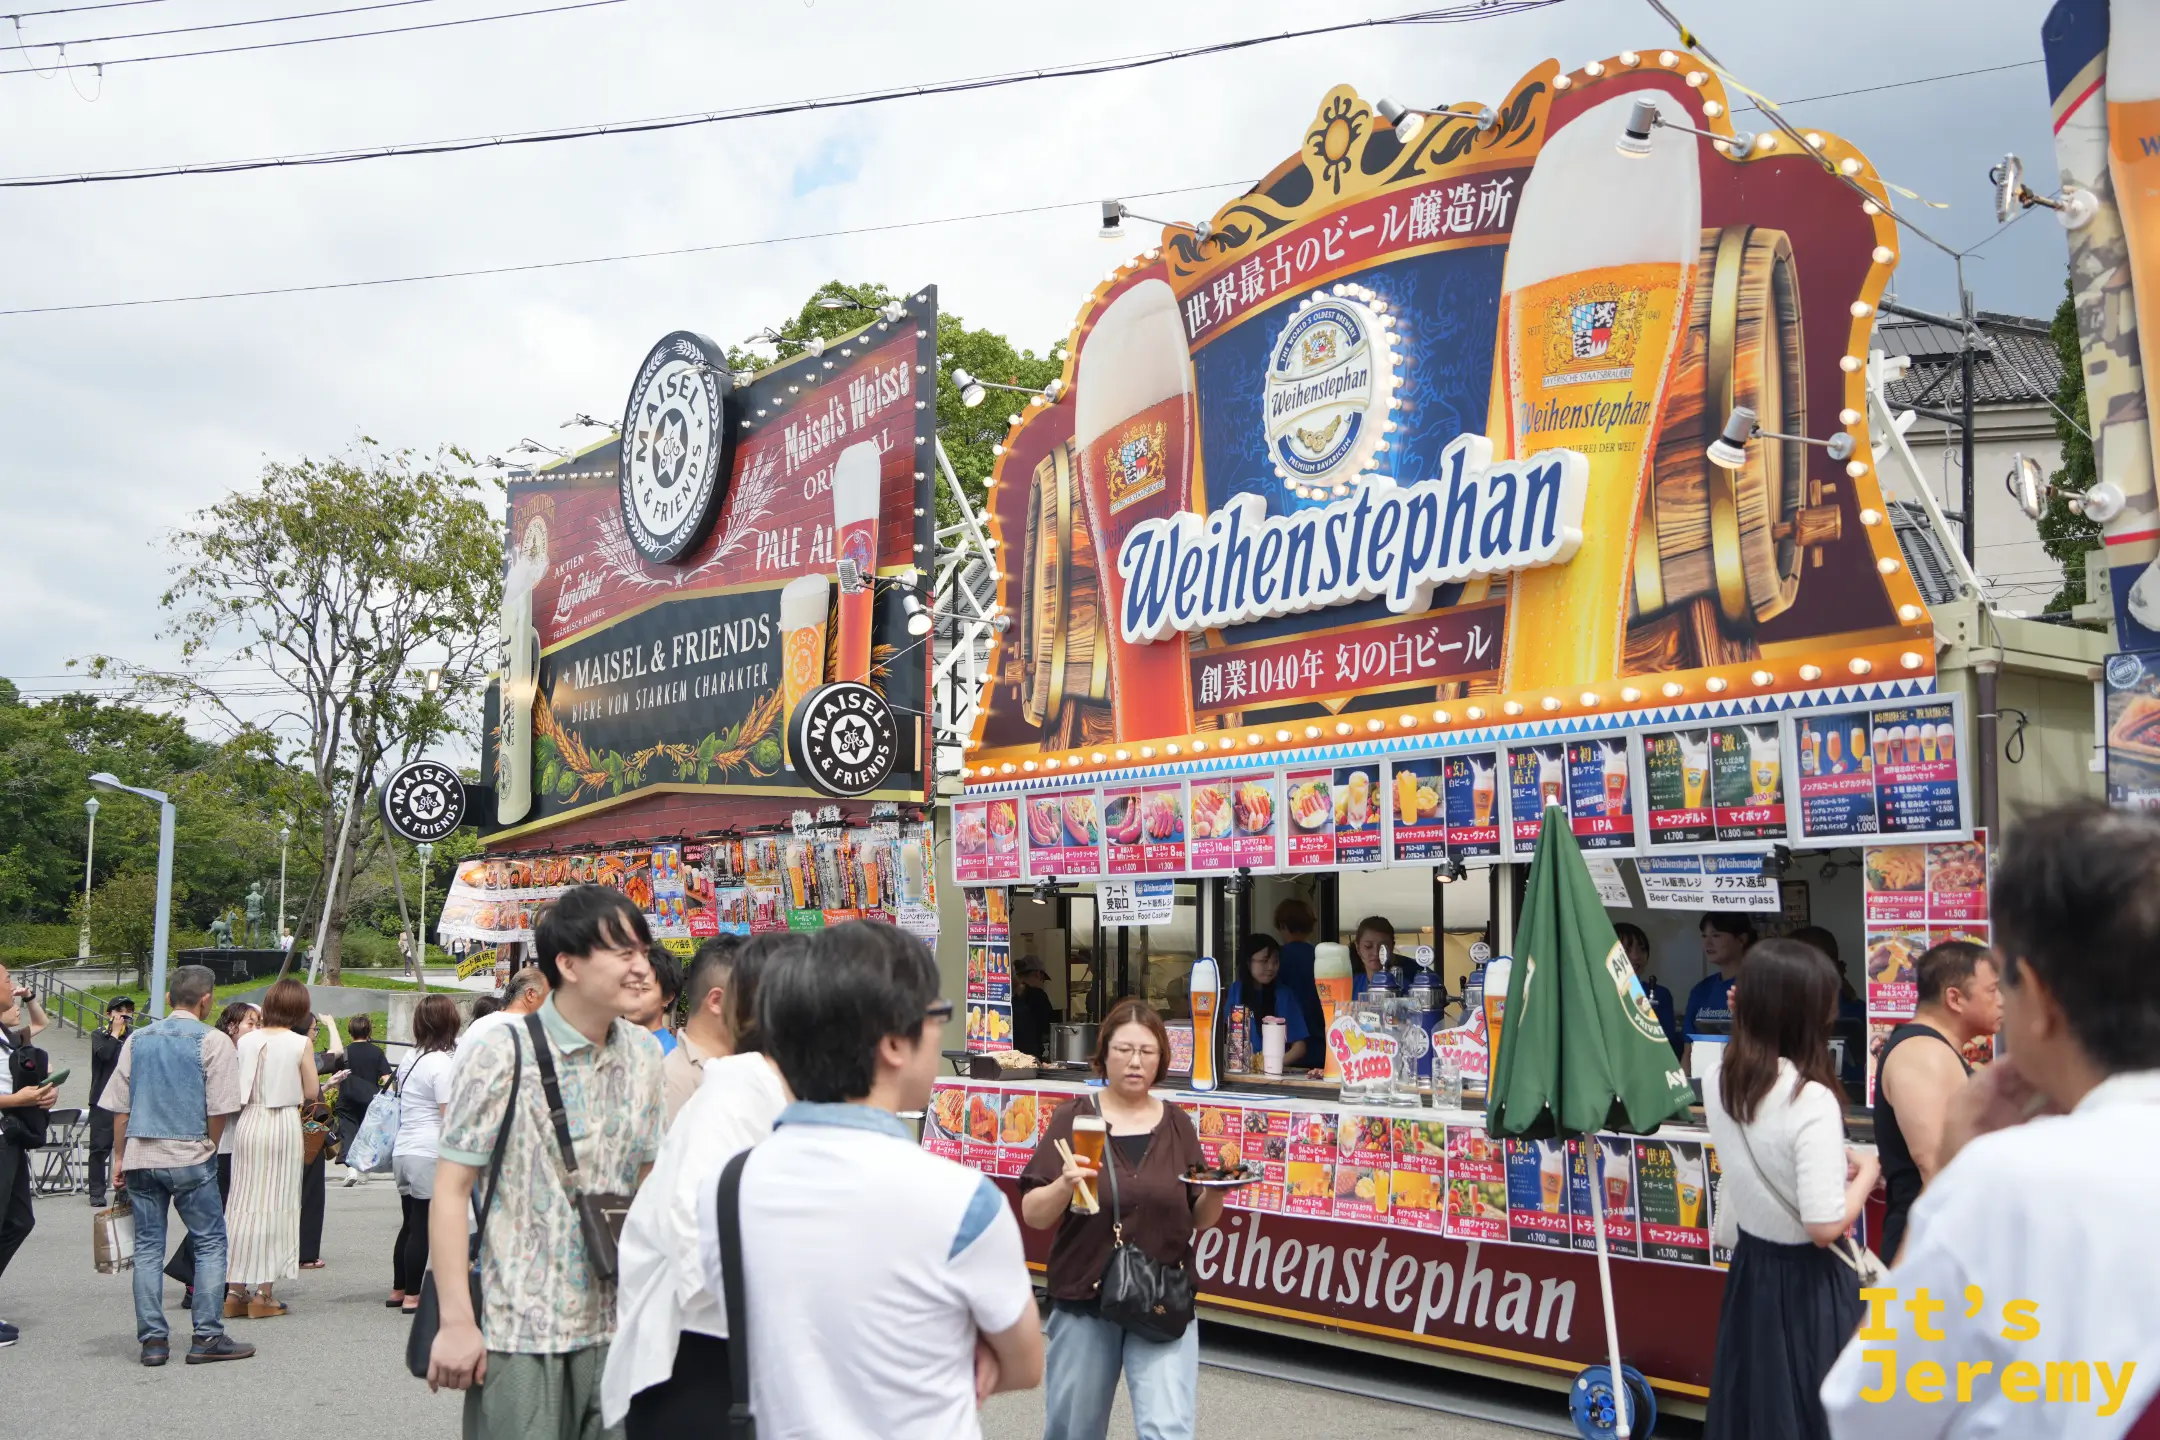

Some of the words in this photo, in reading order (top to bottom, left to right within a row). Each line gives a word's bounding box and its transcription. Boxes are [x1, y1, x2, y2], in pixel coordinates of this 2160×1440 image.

[1185, 176, 1514, 339] 世界最古のビール醸造所
[1280, 347, 1290, 362] THE
[1313, 310, 1336, 321] OLDEST
[1335, 311, 1358, 339] BREWERY
[1527, 324, 1542, 337] SEIT
[1272, 367, 1368, 417] Weihenstephan
[636, 373, 699, 463] MAISEL
[1520, 391, 1650, 436] Weihenstephan
[1599, 442, 1615, 453] DER
[1617, 441, 1636, 452] WELT
[804, 427, 895, 500] ORIAL
[1288, 455, 1316, 473] PREMIUM
[1316, 439, 1352, 471] BAVARICUM
[644, 487, 653, 507] &
[653, 444, 702, 522] FRIENDS
[756, 527, 803, 571] PALE
[809, 524, 837, 564] AL
[1123, 446, 1562, 634] Weihenstephan
[554, 554, 585, 580] AKTIEN
[574, 644, 647, 690] MAISEL
[650, 639, 666, 673] &
[672, 613, 770, 668] FRIENDS
[1199, 649, 1325, 705] 創業1040年
[1335, 625, 1493, 683] 幻の白ビール
[2110, 661, 2137, 680] LIMITED
[572, 698, 602, 723] BIERE
[608, 692, 628, 716] VON
[636, 680, 687, 711] STARKEM
[695, 662, 768, 699] CHARAKTER
[810, 692, 888, 742] MAISEL
[1654, 738, 1678, 757] 世界
[821, 756, 834, 772] &
[833, 744, 890, 786] FRIENDS
[392, 767, 454, 805] MAISEL
[1449, 779, 1471, 788] 白ビール
[1802, 781, 1838, 791] ノンアルコール
[401, 814, 411, 827] &
[412, 803, 458, 835] FRIENDS
[1656, 812, 1707, 826] ヤーフンデルト
[1729, 810, 1771, 822] マイボック
[1592, 819, 1614, 832] IPA
[1851, 822, 1877, 832] ¥1,000
[1450, 830, 1497, 841] ヘフェ・ヴァイス
[1651, 858, 1699, 870] Weihenstephan
[1718, 857, 1762, 869] Weihensteph
[1645, 876, 1702, 888] ビール販売レジ
[1714, 876, 1767, 888] グラス返却
[1105, 885, 1128, 897] フード
[1650, 893, 1668, 902] Beer
[1671, 893, 1704, 904] Cashier
[1106, 898, 1129, 910] 受取口
[1137, 899, 1171, 908] フード販売レジ
[1712, 895, 1746, 905] Return
[1749, 895, 1775, 907] glass
[1152, 911, 1170, 919] Cashier
[1945, 910, 1967, 918] ¥1,500
[1365, 1037, 1397, 1055] DEPOSIT
[1433, 1031, 1465, 1047] DEPOSIT
[1511, 1155, 1537, 1166] 白ビール
[1646, 1148, 1671, 1166] 世界
[1643, 1181, 1673, 1190] ラガービール
[1514, 1214, 1567, 1229] ヘフェ・ヴァイス
[1648, 1228, 1703, 1244] ヤーフンデルト
[1657, 1248, 1678, 1258] ¥1,700
[1190, 1213, 1577, 1343] eihenstephan
